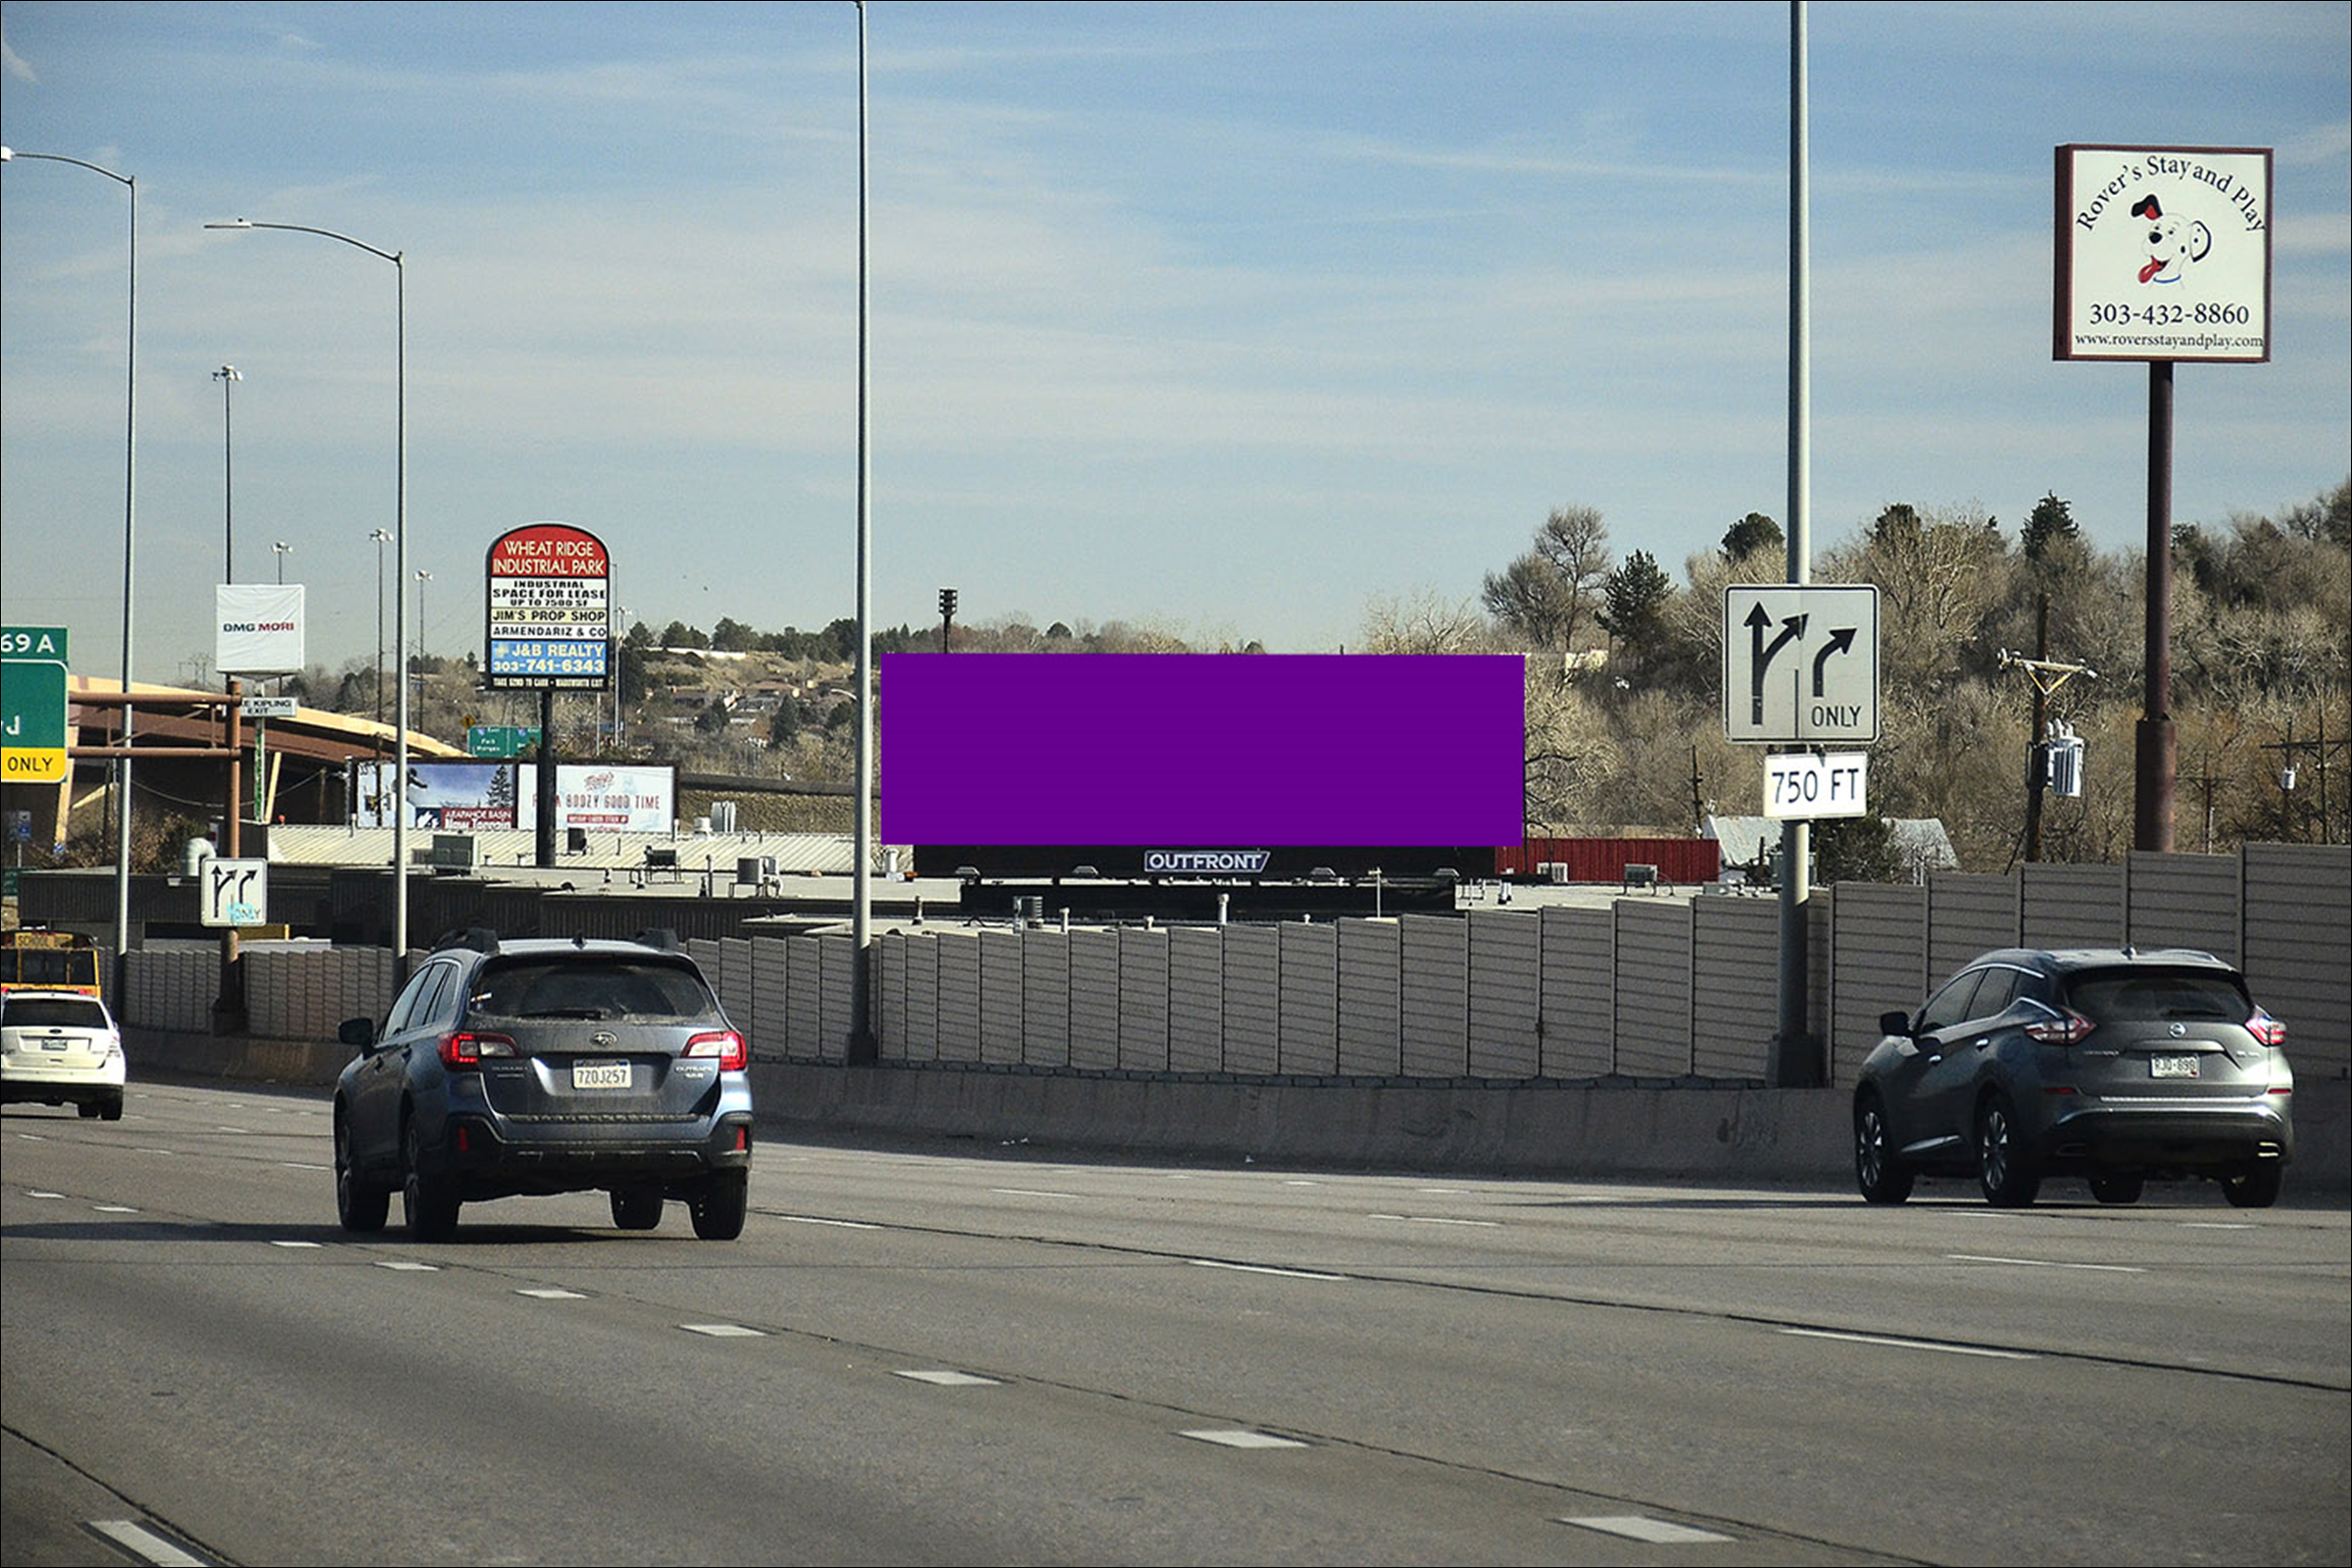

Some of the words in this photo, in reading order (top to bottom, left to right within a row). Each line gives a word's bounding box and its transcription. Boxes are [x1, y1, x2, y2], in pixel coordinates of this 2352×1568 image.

[2076, 165, 2143, 231] Rover's
[2146, 155, 2192, 180] Stay
[2192, 166, 2233, 194] and
[2230, 186, 2267, 233] Play
[2089, 303, 2250, 325] 303-432-8860
[2075, 332, 2265, 350] www.roversstayandplay.com
[504, 540, 554, 557] WHEAT
[556, 541, 594, 558] RIDGE
[492, 558, 567, 574] INDUSTRIAL
[571, 560, 605, 575] PARK
[514, 580, 585, 589] INDUSTRIAL
[493, 589, 535, 598] SPACE
[539, 589, 564, 599] FOR
[568, 589, 606, 599] LEASE
[493, 610, 526, 621] JIM'S
[531, 610, 566, 621] PROP
[571, 610, 606, 621] SHOP
[223, 623, 255, 632] DMG
[258, 622, 294, 631] MORI
[493, 626, 573, 637] ARMENDARIZ
[577, 626, 585, 637] &
[589, 626, 607, 637] CO
[36, 634, 55, 654] A
[513, 644, 542, 658] J&B
[548, 644, 605, 658] REALTY
[493, 659, 605, 672] 303-741-6343
[1811, 706, 1861, 727] ONLY
[7, 757, 53, 772] ONLY
[1772, 770, 1819, 804] 750
[1831, 768, 1859, 801] FT
[635, 796, 661, 810] TIME
[1149, 854, 1262, 869] OUTFRONT
